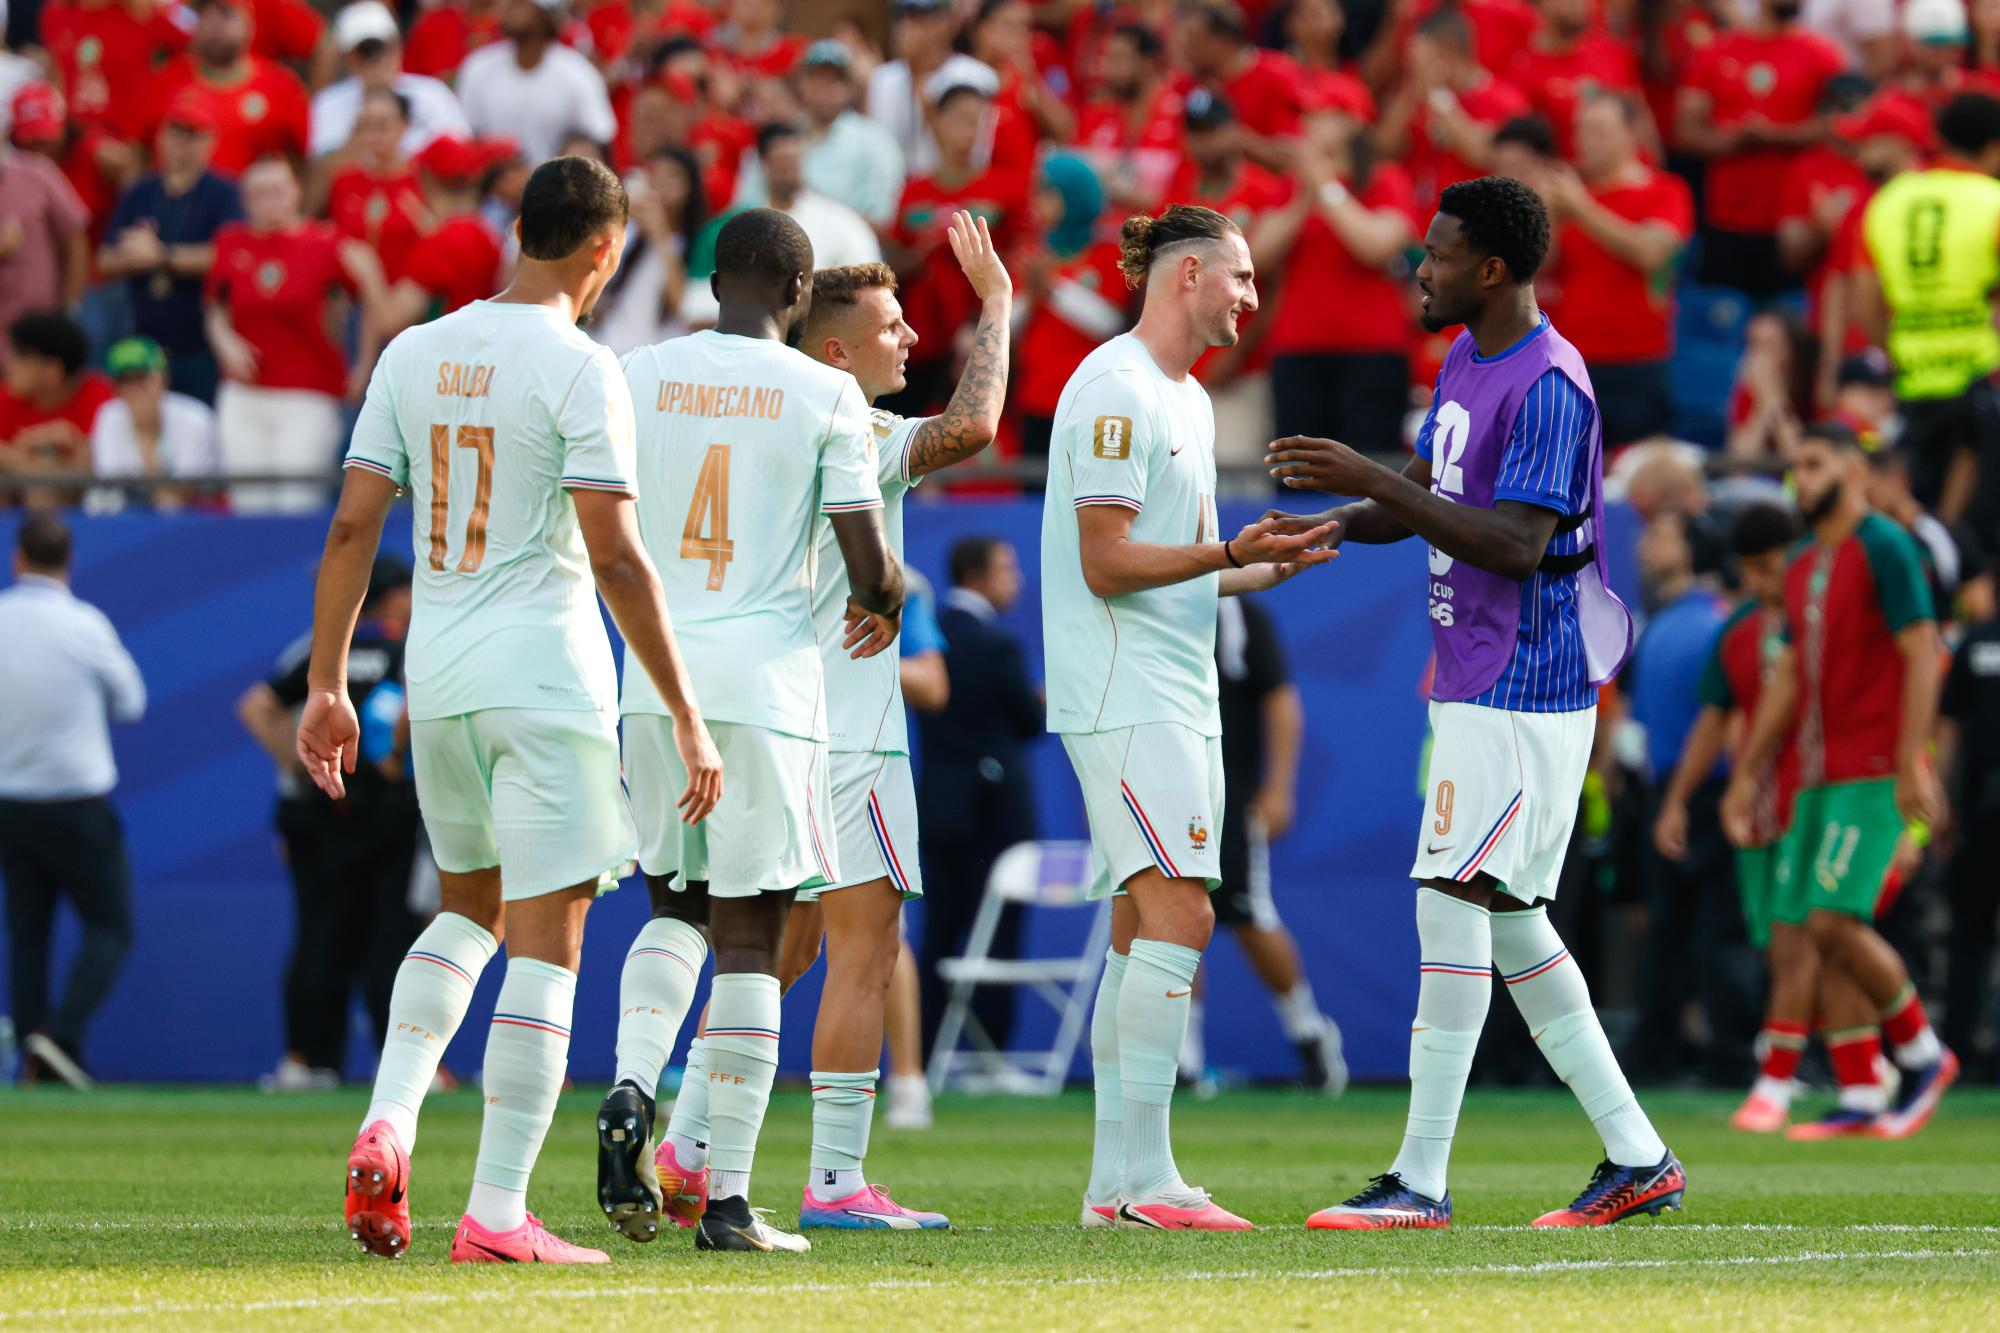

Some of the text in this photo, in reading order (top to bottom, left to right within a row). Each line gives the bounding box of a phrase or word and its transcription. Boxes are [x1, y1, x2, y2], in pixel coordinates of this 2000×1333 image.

[656, 380, 784, 419] UPAMECANO
[429, 424, 495, 573] 17
[680, 443, 734, 592] 4
[1433, 582, 1454, 600] CUP
[1435, 780, 1454, 836] 9
[710, 1072, 746, 1085] FFF
